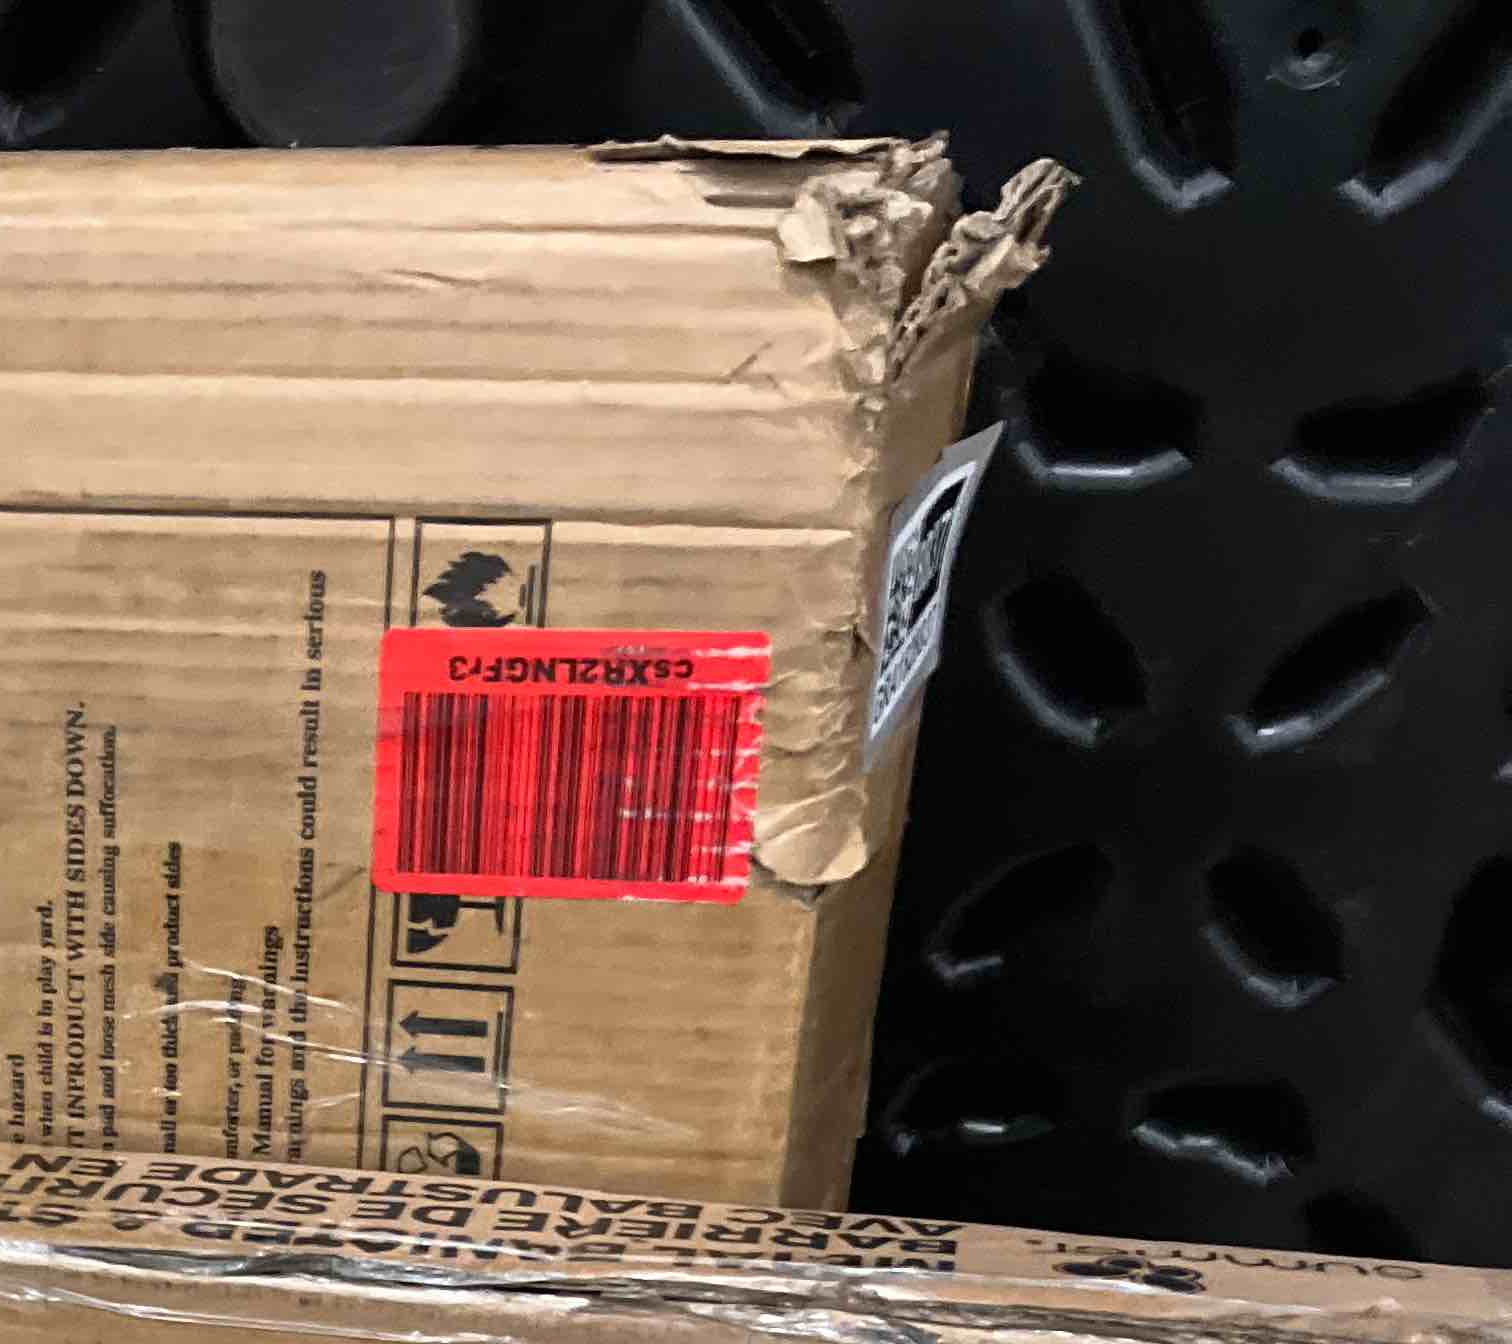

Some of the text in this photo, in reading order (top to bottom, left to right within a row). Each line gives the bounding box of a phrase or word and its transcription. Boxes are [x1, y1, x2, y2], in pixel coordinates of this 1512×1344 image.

[302, 569, 324, 659] serious
[301, 668, 320, 689] in
[66, 701, 84, 797] DOWN.
[298, 700, 319, 766] result
[296, 775, 316, 839] could
[66, 804, 84, 881] SIDES
[99, 845, 119, 915] causing
[66, 890, 84, 962] WITH
[99, 921, 115, 957] side
[165, 893, 183, 966] product
[292, 848, 314, 982] instructions
[37, 955, 55, 994] play
[37, 1021, 52, 1036] is
[37, 1041, 52, 1085] child
[252, 1074, 272, 1154] Manual
[13, 1152, 123, 1181] EN
[144, 1162, 703, 1219] BALUSTRADE
[355, 1198, 473, 1228] DE
[726, 1206, 967, 1238] AVEC
